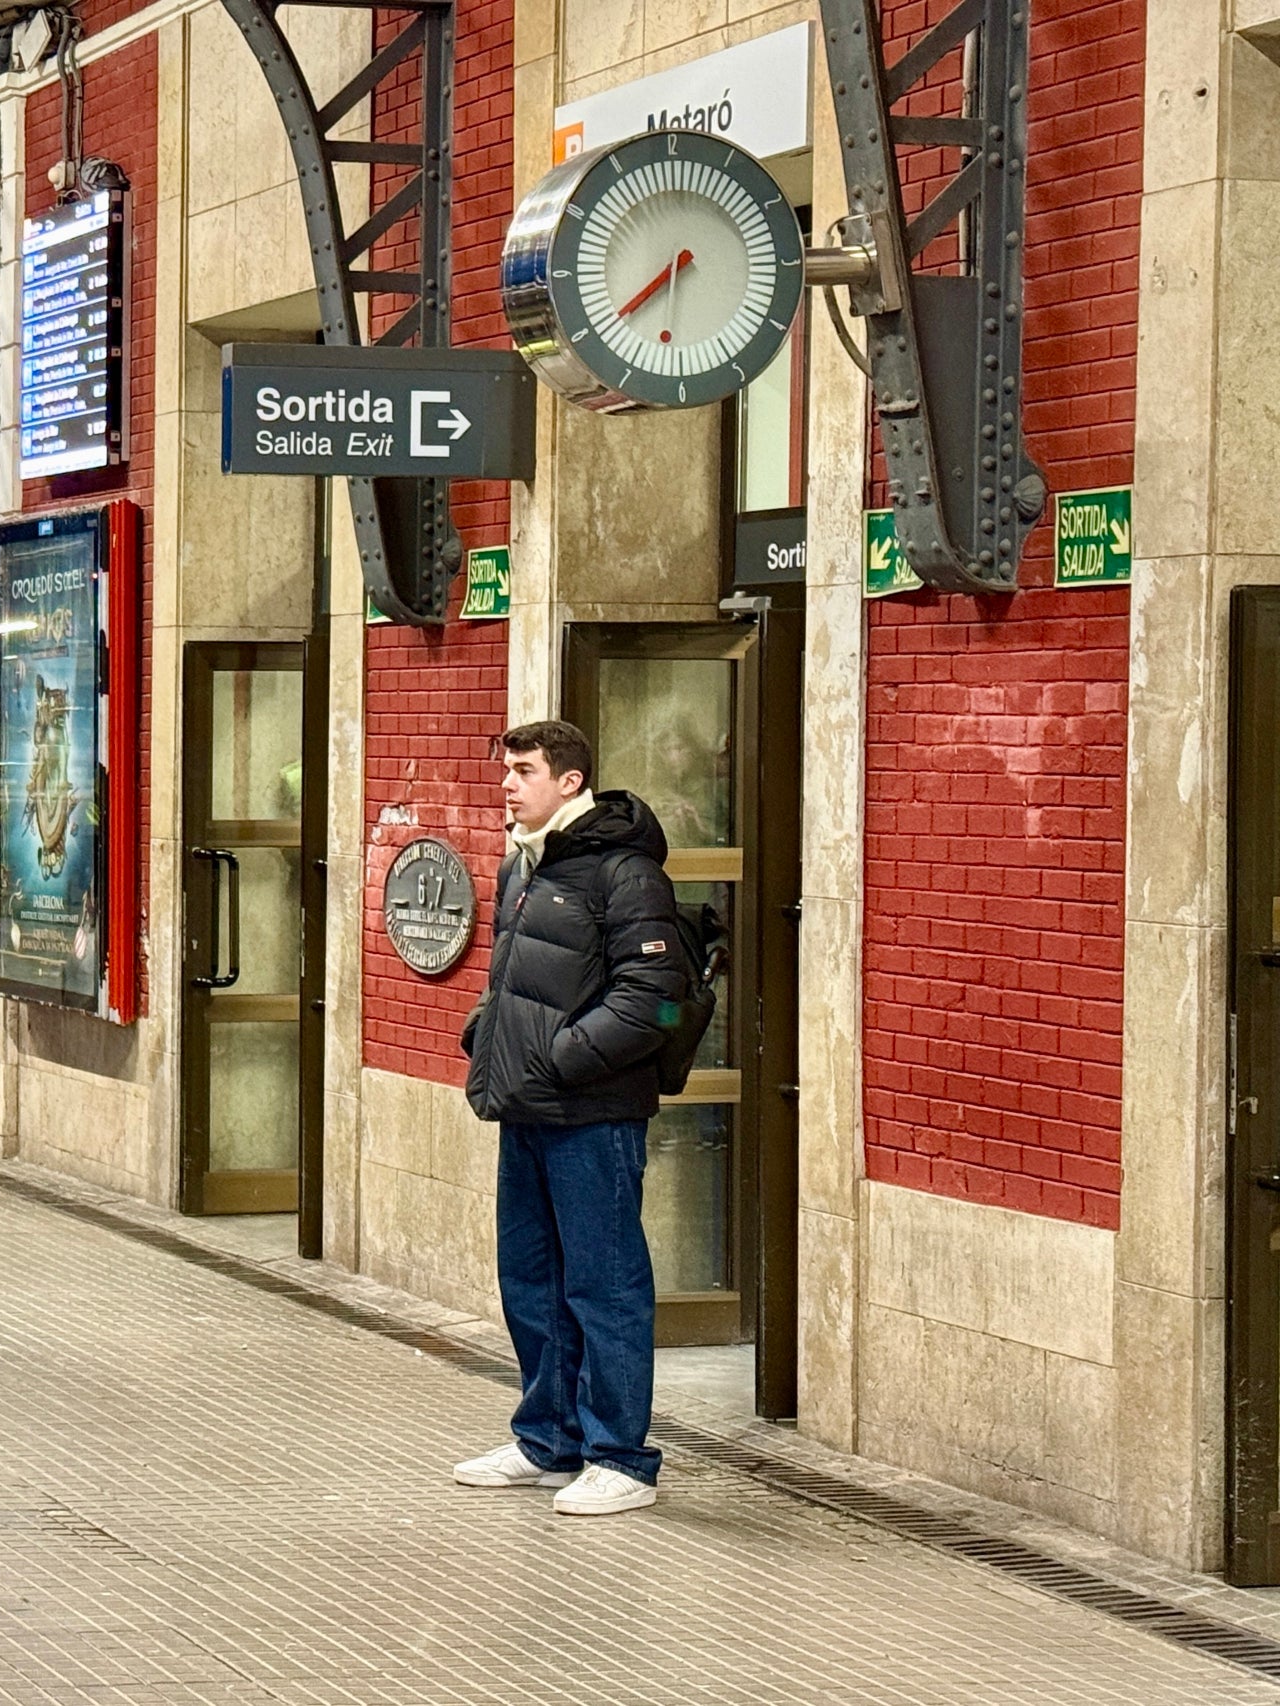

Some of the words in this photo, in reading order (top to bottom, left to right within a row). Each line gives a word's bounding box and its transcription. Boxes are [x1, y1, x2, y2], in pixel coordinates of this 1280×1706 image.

[667, 133, 678, 155] 12
[608, 153, 623, 174] 11
[724, 148, 736, 168] 1
[565, 202, 586, 220] 10
[765, 193, 782, 210] 2
[781, 257, 801, 267] 3
[552, 269, 572, 279] 9
[571, 327, 589, 343] 8
[768, 317, 787, 332] 4
[618, 368, 632, 389] 7
[731, 362, 746, 382] 5
[678, 381, 687, 403] 6
[256, 387, 394, 423] Sortida
[255, 430, 333, 456] Salida
[346, 432, 394, 457] Exit
[1060, 504, 1108, 540] SORTIDA
[767, 541, 806, 570] Sorti
[1062, 543, 1105, 577] SALIDA
[470, 558, 498, 584] SORTIDA
[467, 587, 496, 612] SALIDA
